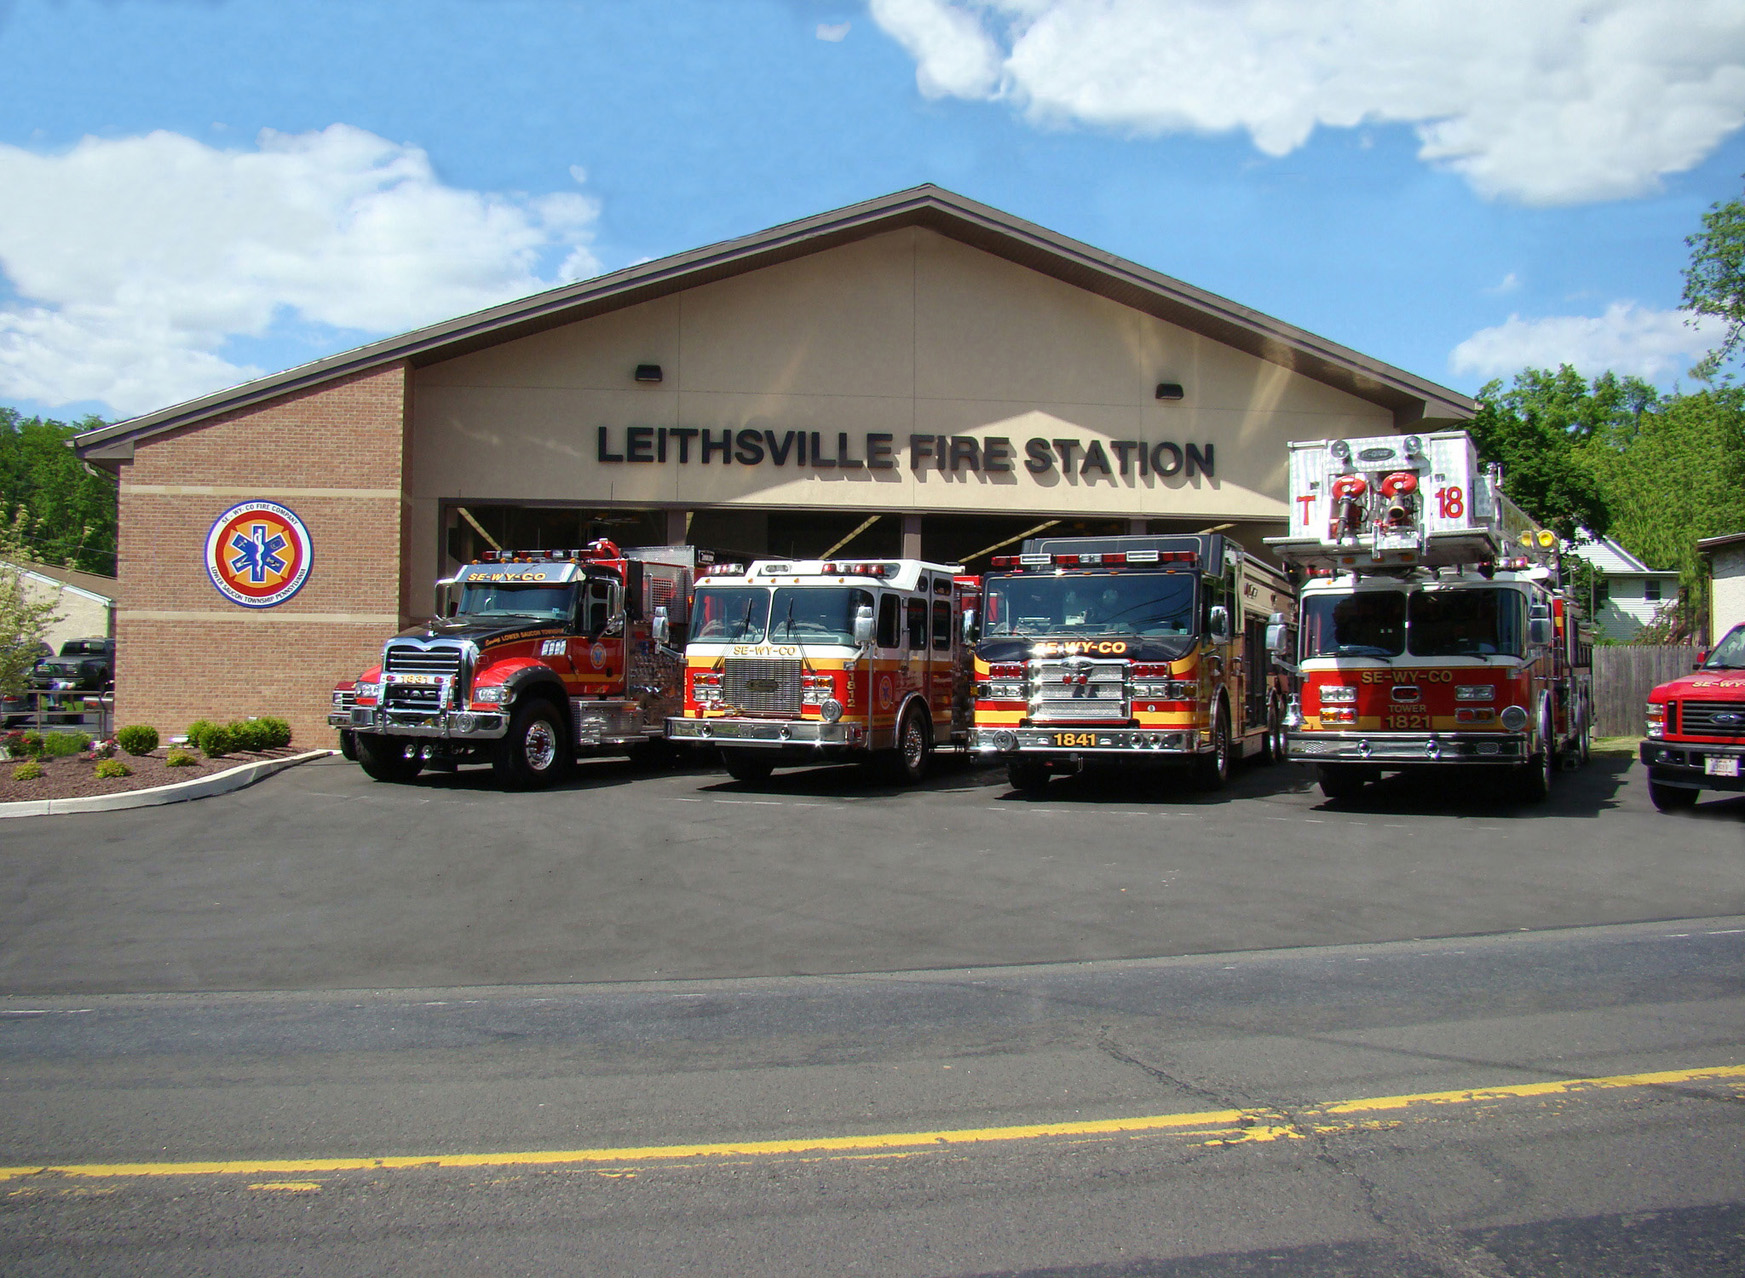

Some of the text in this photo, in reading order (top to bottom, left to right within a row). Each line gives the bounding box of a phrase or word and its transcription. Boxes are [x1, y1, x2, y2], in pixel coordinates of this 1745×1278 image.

[598, 427, 1215, 478] LEITHSVILLE FIRE STATION
[1296, 486, 1464, 526] T 18
[256, 503, 271, 511] FIRE
[271, 505, 299, 526] COMPANY
[210, 565, 307, 604] LOWER SAUCON TOWNSHIP PENNSYLVANIA
[468, 573, 546, 582] SE-WY-CO
[733, 646, 796, 656] SE-WY-CO
[401, 674, 430, 684] 1831
[1361, 670, 1453, 684] SE-WY-CO
[846, 672, 857, 709] 1812
[1388, 704, 1427, 713] TOWER
[1386, 715, 1431, 729] 1821
[1053, 733, 1097, 747] 1841
